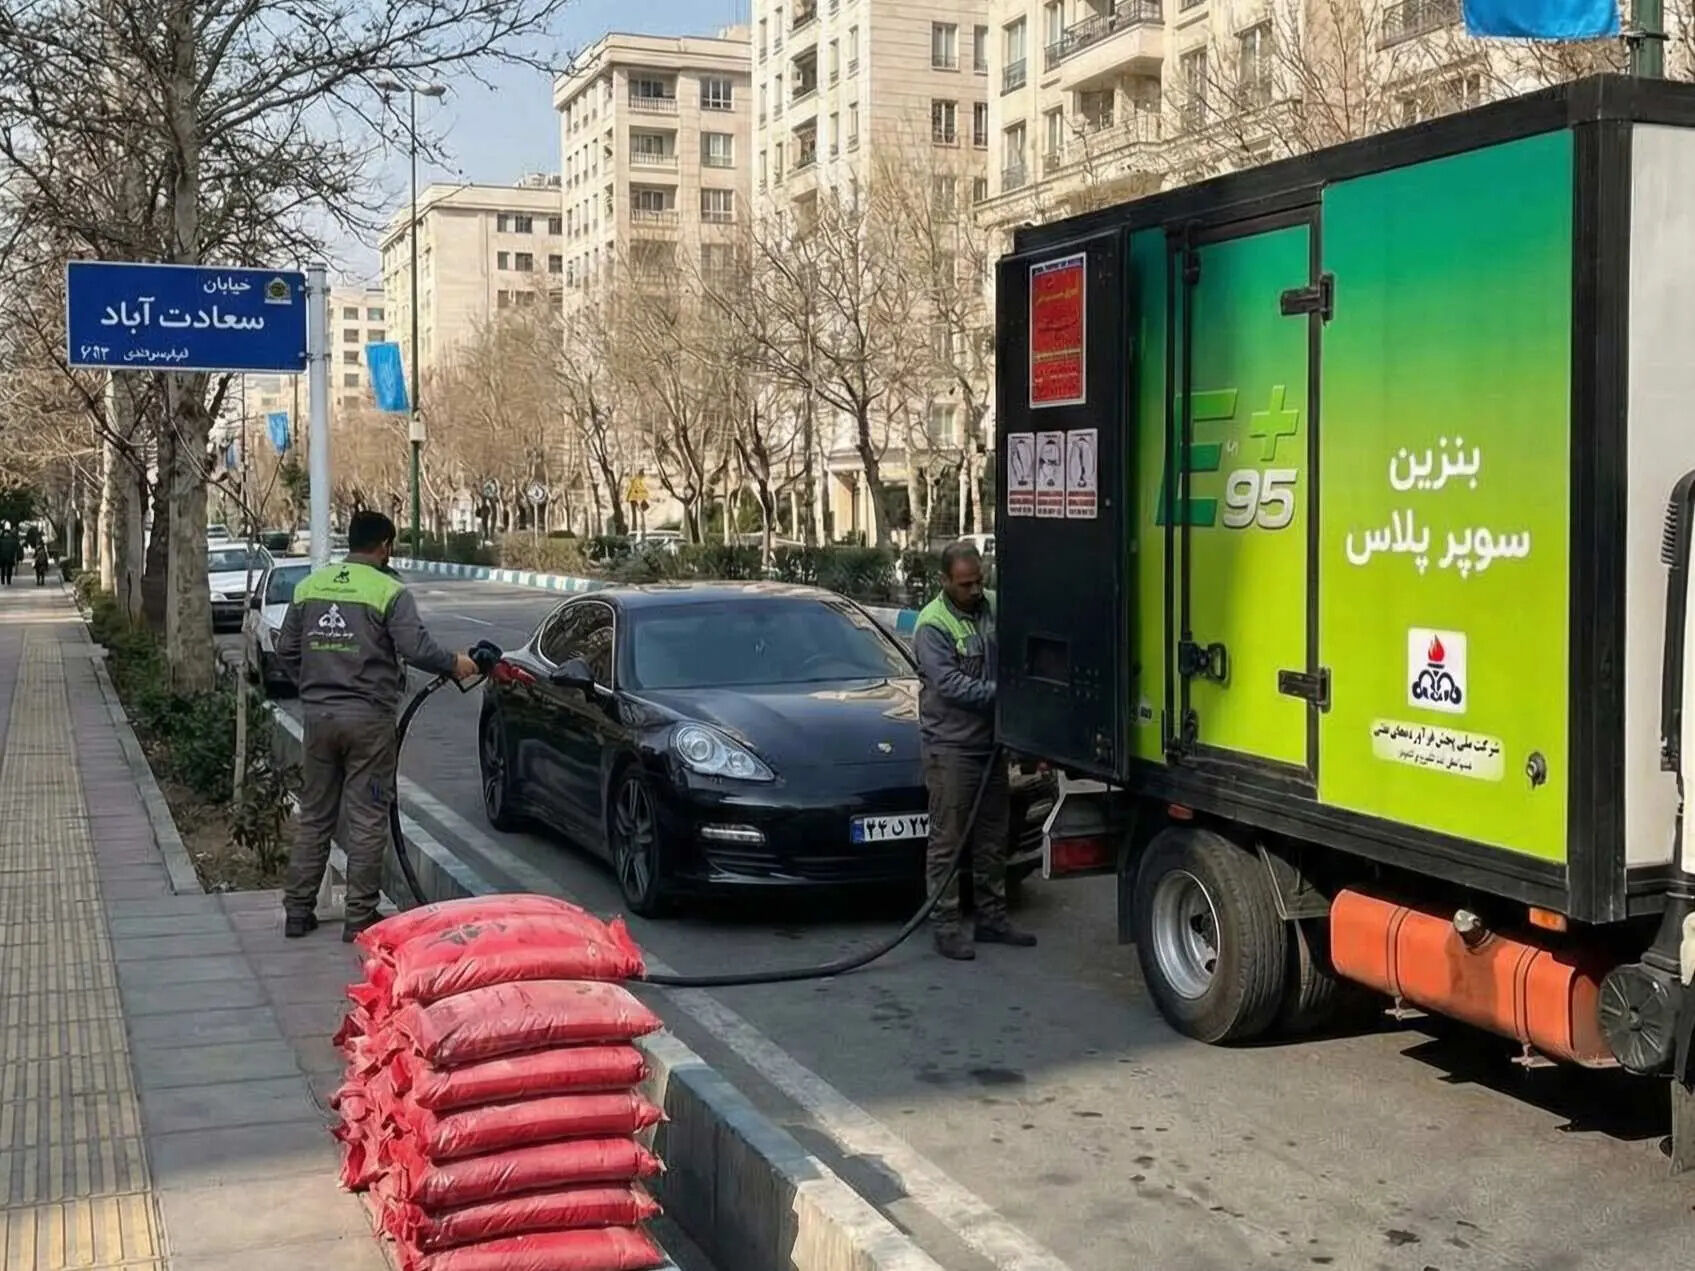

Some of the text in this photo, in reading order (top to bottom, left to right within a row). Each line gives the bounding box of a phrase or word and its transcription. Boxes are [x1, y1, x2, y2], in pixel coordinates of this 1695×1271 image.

[203, 276, 251, 295] خیابان
[101, 297, 264, 334] سعادت آباد
[1389, 436, 1480, 491] بنزین
[1223, 468, 1297, 529] 95
[1346, 508, 1530, 579] سوپر پلاس
